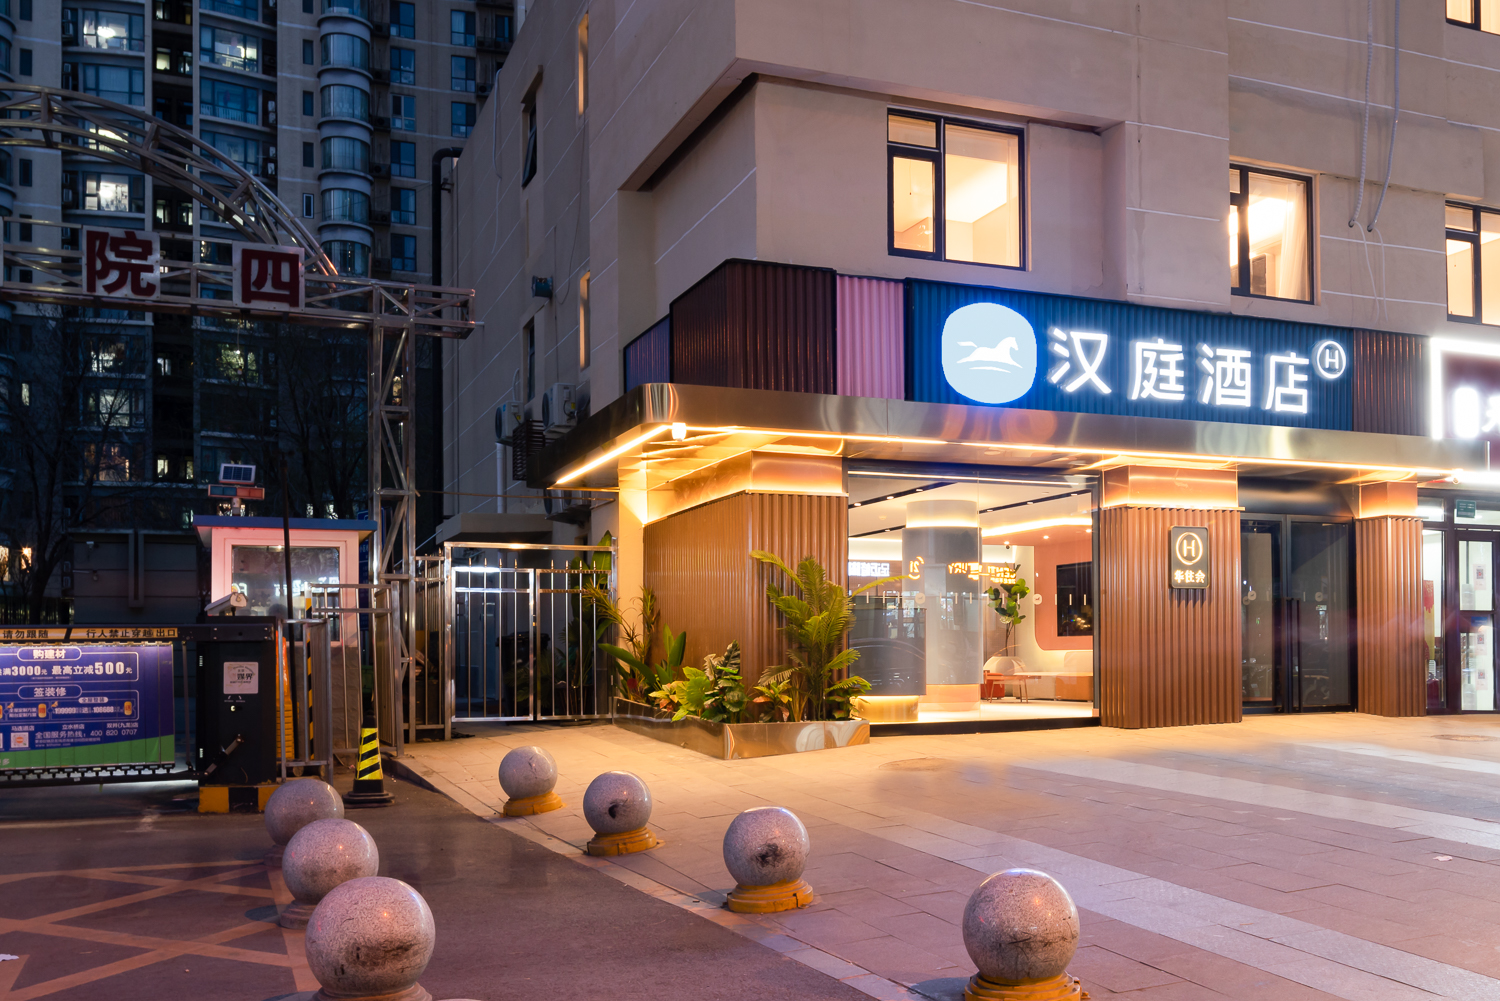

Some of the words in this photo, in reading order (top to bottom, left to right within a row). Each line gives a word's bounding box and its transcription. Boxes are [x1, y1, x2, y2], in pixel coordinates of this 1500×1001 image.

[1046, 326, 1311, 415] 汉庭酒店
[1173, 569, 1206, 584] 华住会
[2, 629, 49, 639] 请勿跟随
[86, 629, 177, 639] 行人禁止穿越出口
[51, 661, 133, 676] 最高立减500元
[33, 687, 67, 697] 签装修
